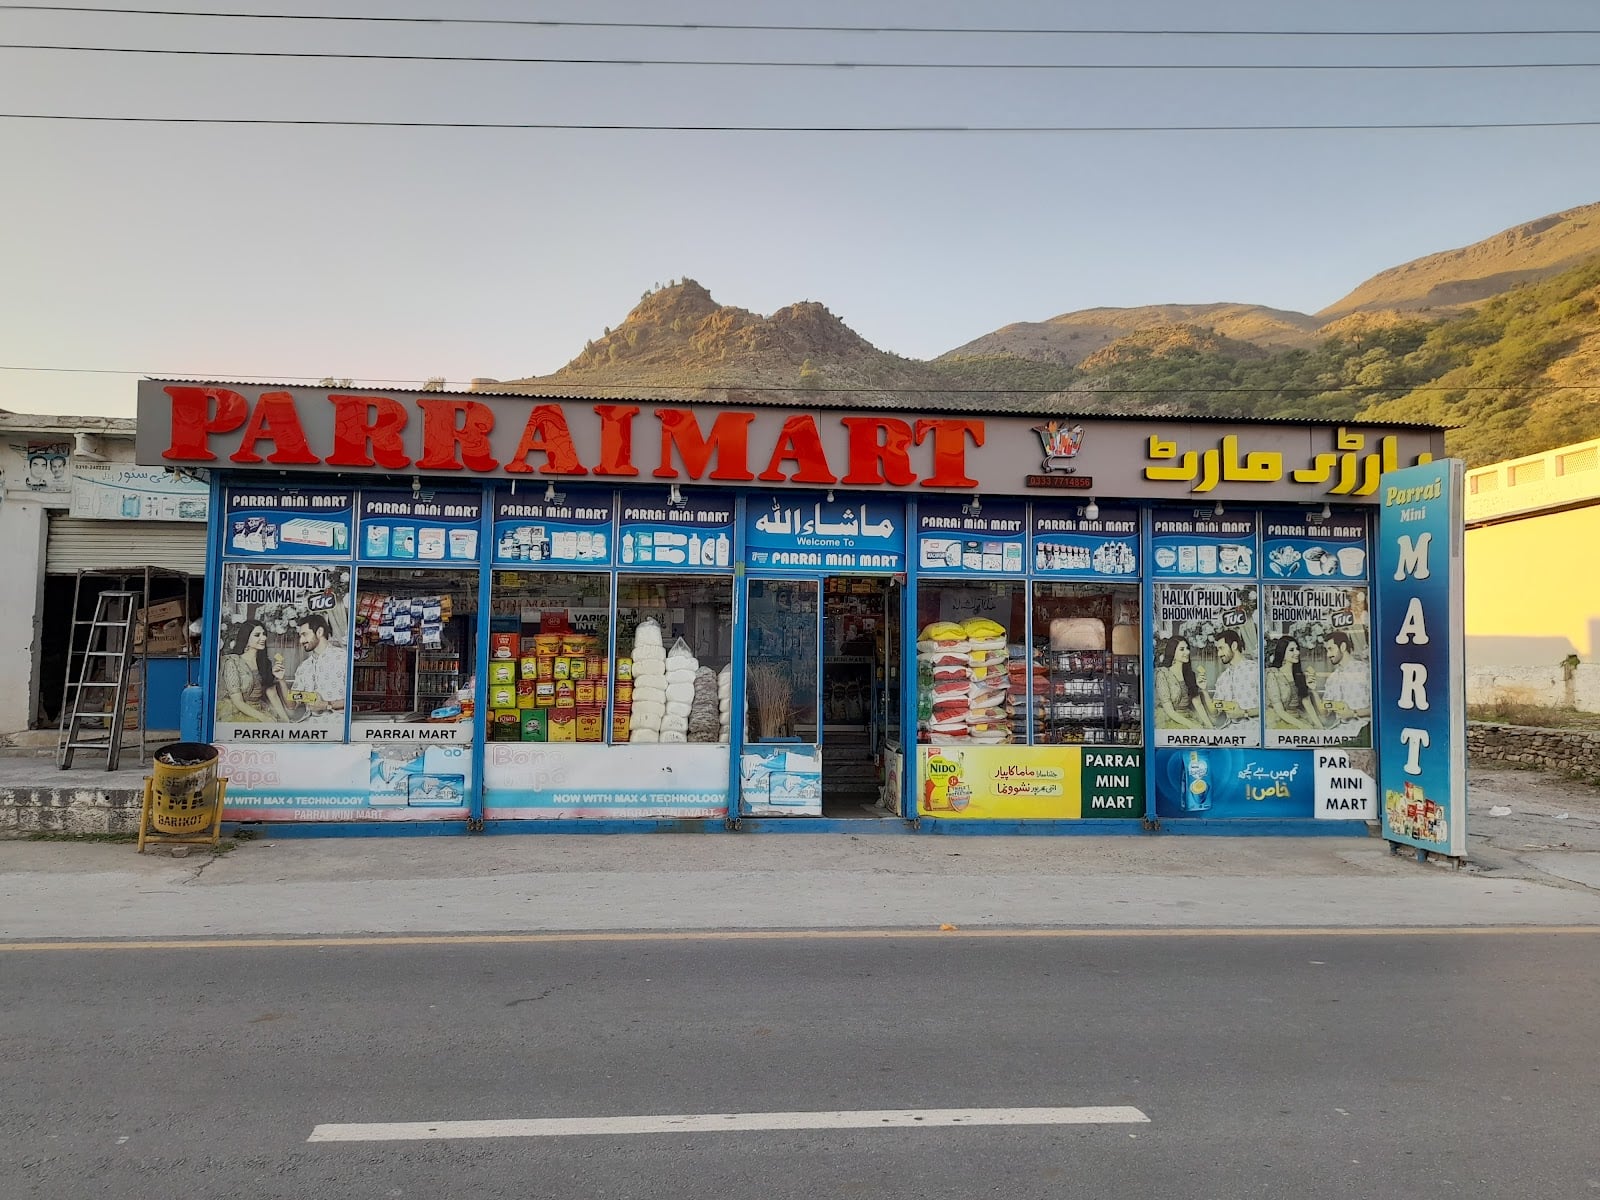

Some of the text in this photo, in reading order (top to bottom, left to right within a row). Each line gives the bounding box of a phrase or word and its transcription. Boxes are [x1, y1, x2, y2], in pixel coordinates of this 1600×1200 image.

[1144, 434, 1284, 493] مارٹ
[1030, 477, 1051, 485] 0333
[1386, 477, 1441, 507] Parrai
[308, 495, 348, 507] MART
[444, 504, 478, 517] MART
[575, 507, 608, 520] MART
[697, 510, 730, 523] MART
[1400, 506, 1427, 523] Mini
[991, 519, 1022, 532] MART
[1105, 521, 1135, 533] MART
[1221, 522, 1251, 533] MART
[1333, 526, 1363, 537] MART
[797, 537, 854, 547] Welcome To
[860, 554, 899, 567] MART
[236, 568, 326, 589] HALKI PHULKI
[236, 588, 274, 603] BHOOK
[1162, 590, 1237, 607] HALKI PHULKI
[1272, 590, 1346, 607] HALKI PHULKI
[1162, 607, 1193, 620] BHOOK
[1272, 608, 1303, 621] BHOOK
[1394, 532, 1432, 775] MART
[234, 729, 329, 740] PARRAI MART
[365, 729, 457, 740] PARRAI MART
[1167, 735, 1247, 745] PARRAI MART
[1278, 735, 1320, 745] PARRAI
[1085, 754, 1140, 767] PARRAI
[1320, 757, 1351, 769] PAR
[930, 763, 956, 773] NIDO
[218, 764, 280, 791] Papa
[1270, 769, 1289, 780] میں
[1095, 775, 1130, 788] MINI
[1331, 777, 1362, 789] MINI
[235, 796, 260, 805] WITH
[263, 796, 285, 805] MAX
[287, 796, 293, 805] 4
[296, 796, 364, 805] TECHNOLOGY
[553, 794, 726, 804] NOW WITH MAX 4 TECHNOLOGY
[1091, 796, 1135, 809] MART
[1326, 798, 1367, 810] MART
[294, 809, 383, 820] PARRAI MINI MART
[683, 808, 714, 817] MART
